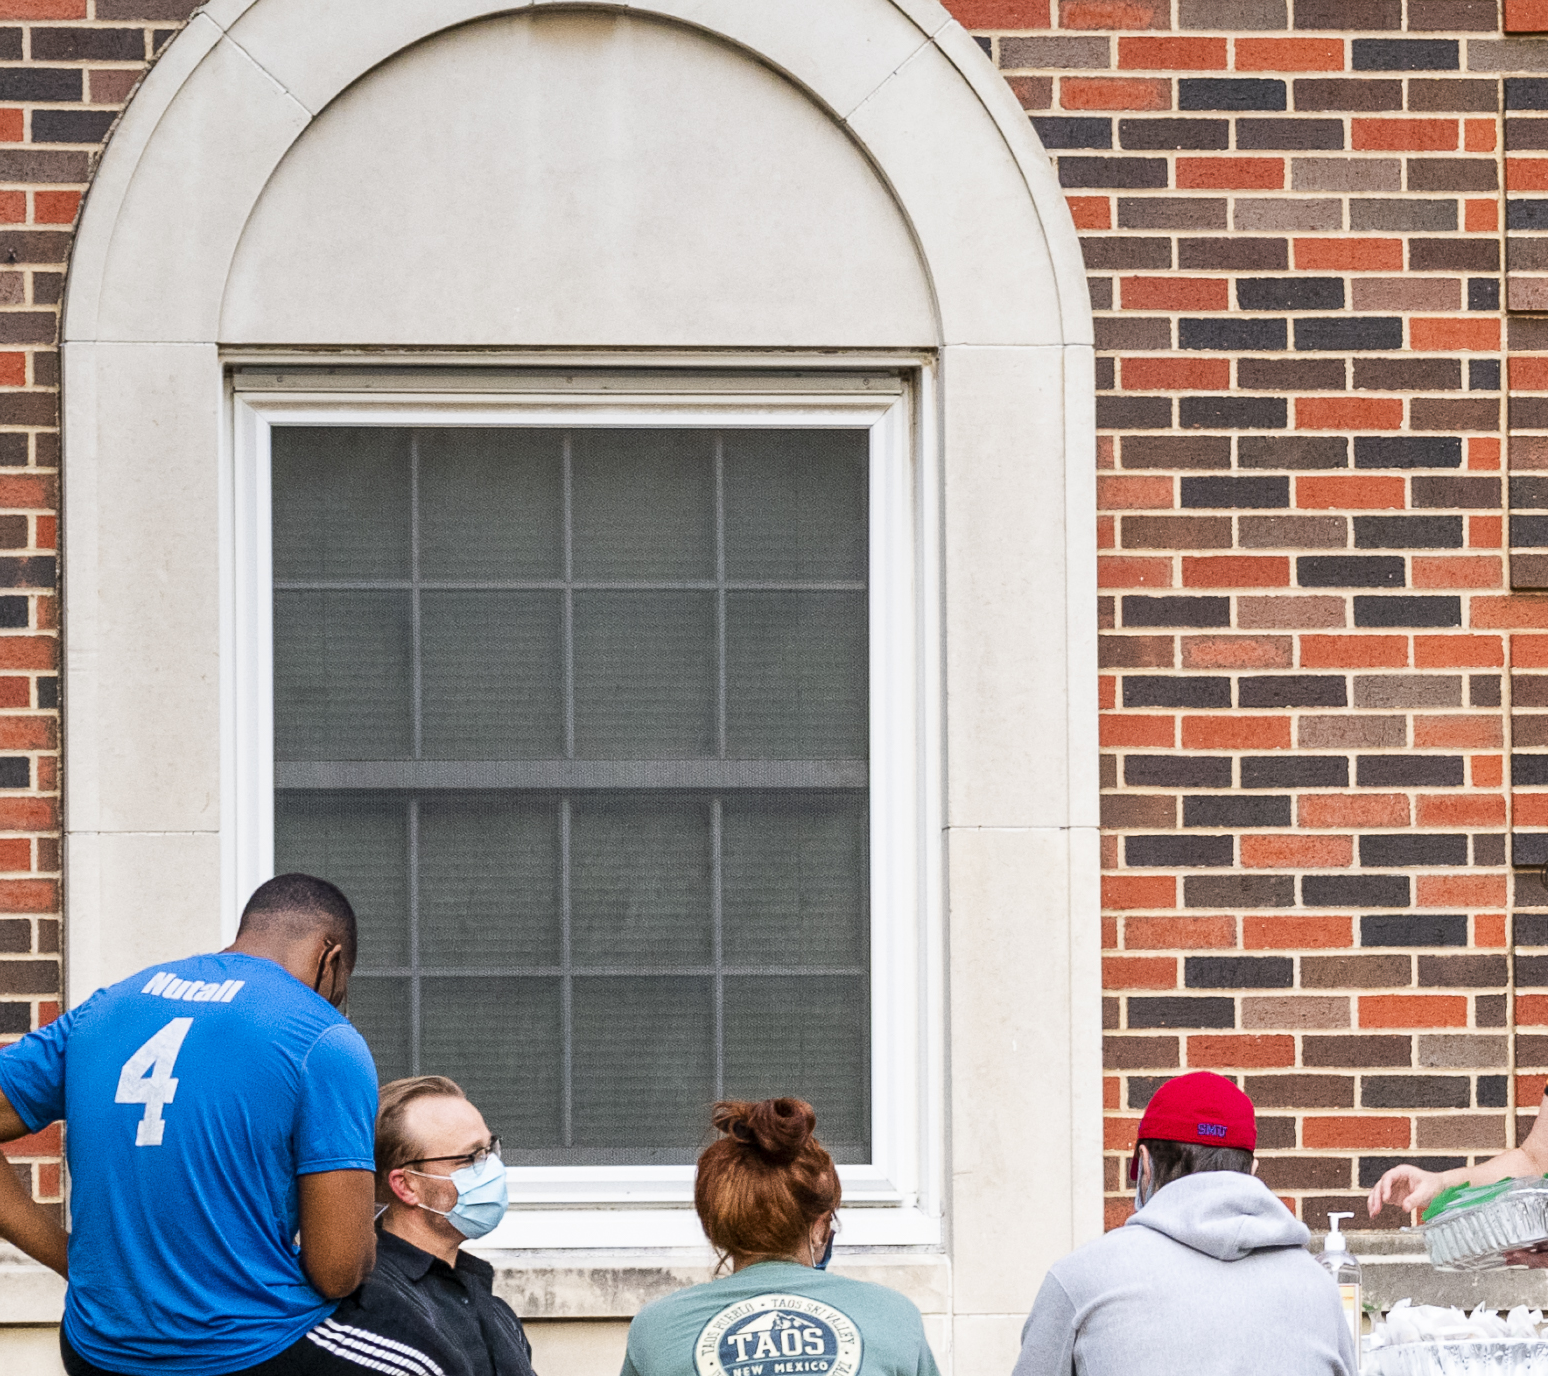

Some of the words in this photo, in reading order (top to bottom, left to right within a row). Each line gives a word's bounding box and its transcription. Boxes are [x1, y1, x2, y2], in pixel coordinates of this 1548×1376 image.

[141, 971, 245, 1003] Nutall
[114, 1016, 195, 1147] 4
[1197, 1122, 1228, 1138] SMU
[702, 1331, 720, 1356] TAOS
[716, 1302, 755, 1331] PUEBLO
[771, 1298, 802, 1310] TAOS
[804, 1303, 827, 1317] SKI
[824, 1312, 856, 1345] VALLEY
[727, 1327, 825, 1362] TAOS
[774, 1360, 830, 1374] MEXICO
